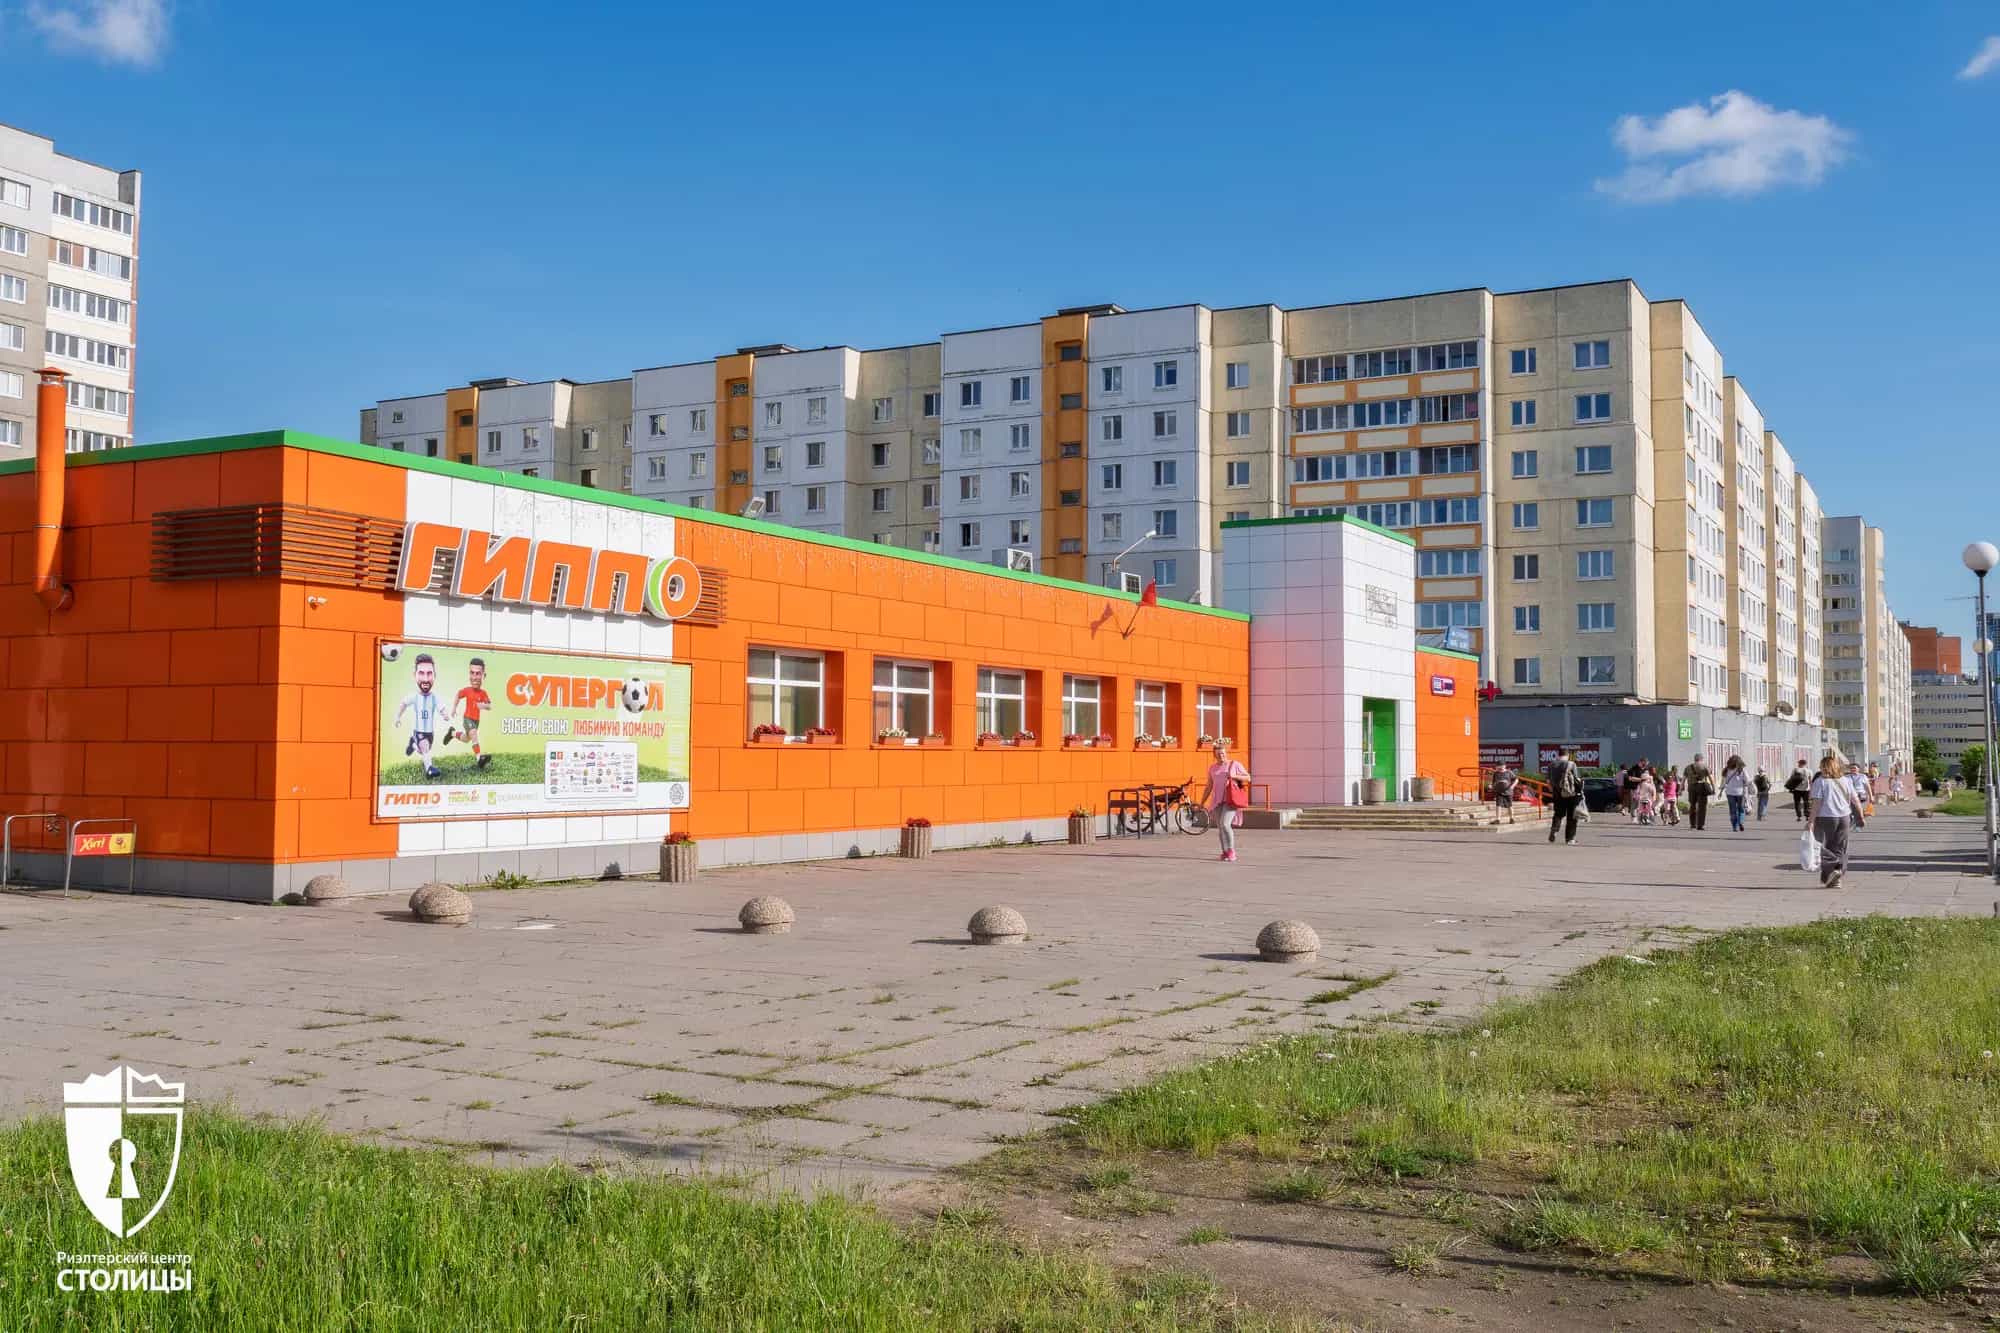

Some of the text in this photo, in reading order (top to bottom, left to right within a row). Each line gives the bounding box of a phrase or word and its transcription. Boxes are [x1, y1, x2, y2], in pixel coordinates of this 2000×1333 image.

[397, 521, 702, 619] ГИППО
[502, 718, 666, 738] СОБЕРИ СВОЮ ЛЮБИМУЮ КОМАНДУ
[1576, 750, 1599, 762] SHOP
[384, 791, 441, 805] ГИППО
